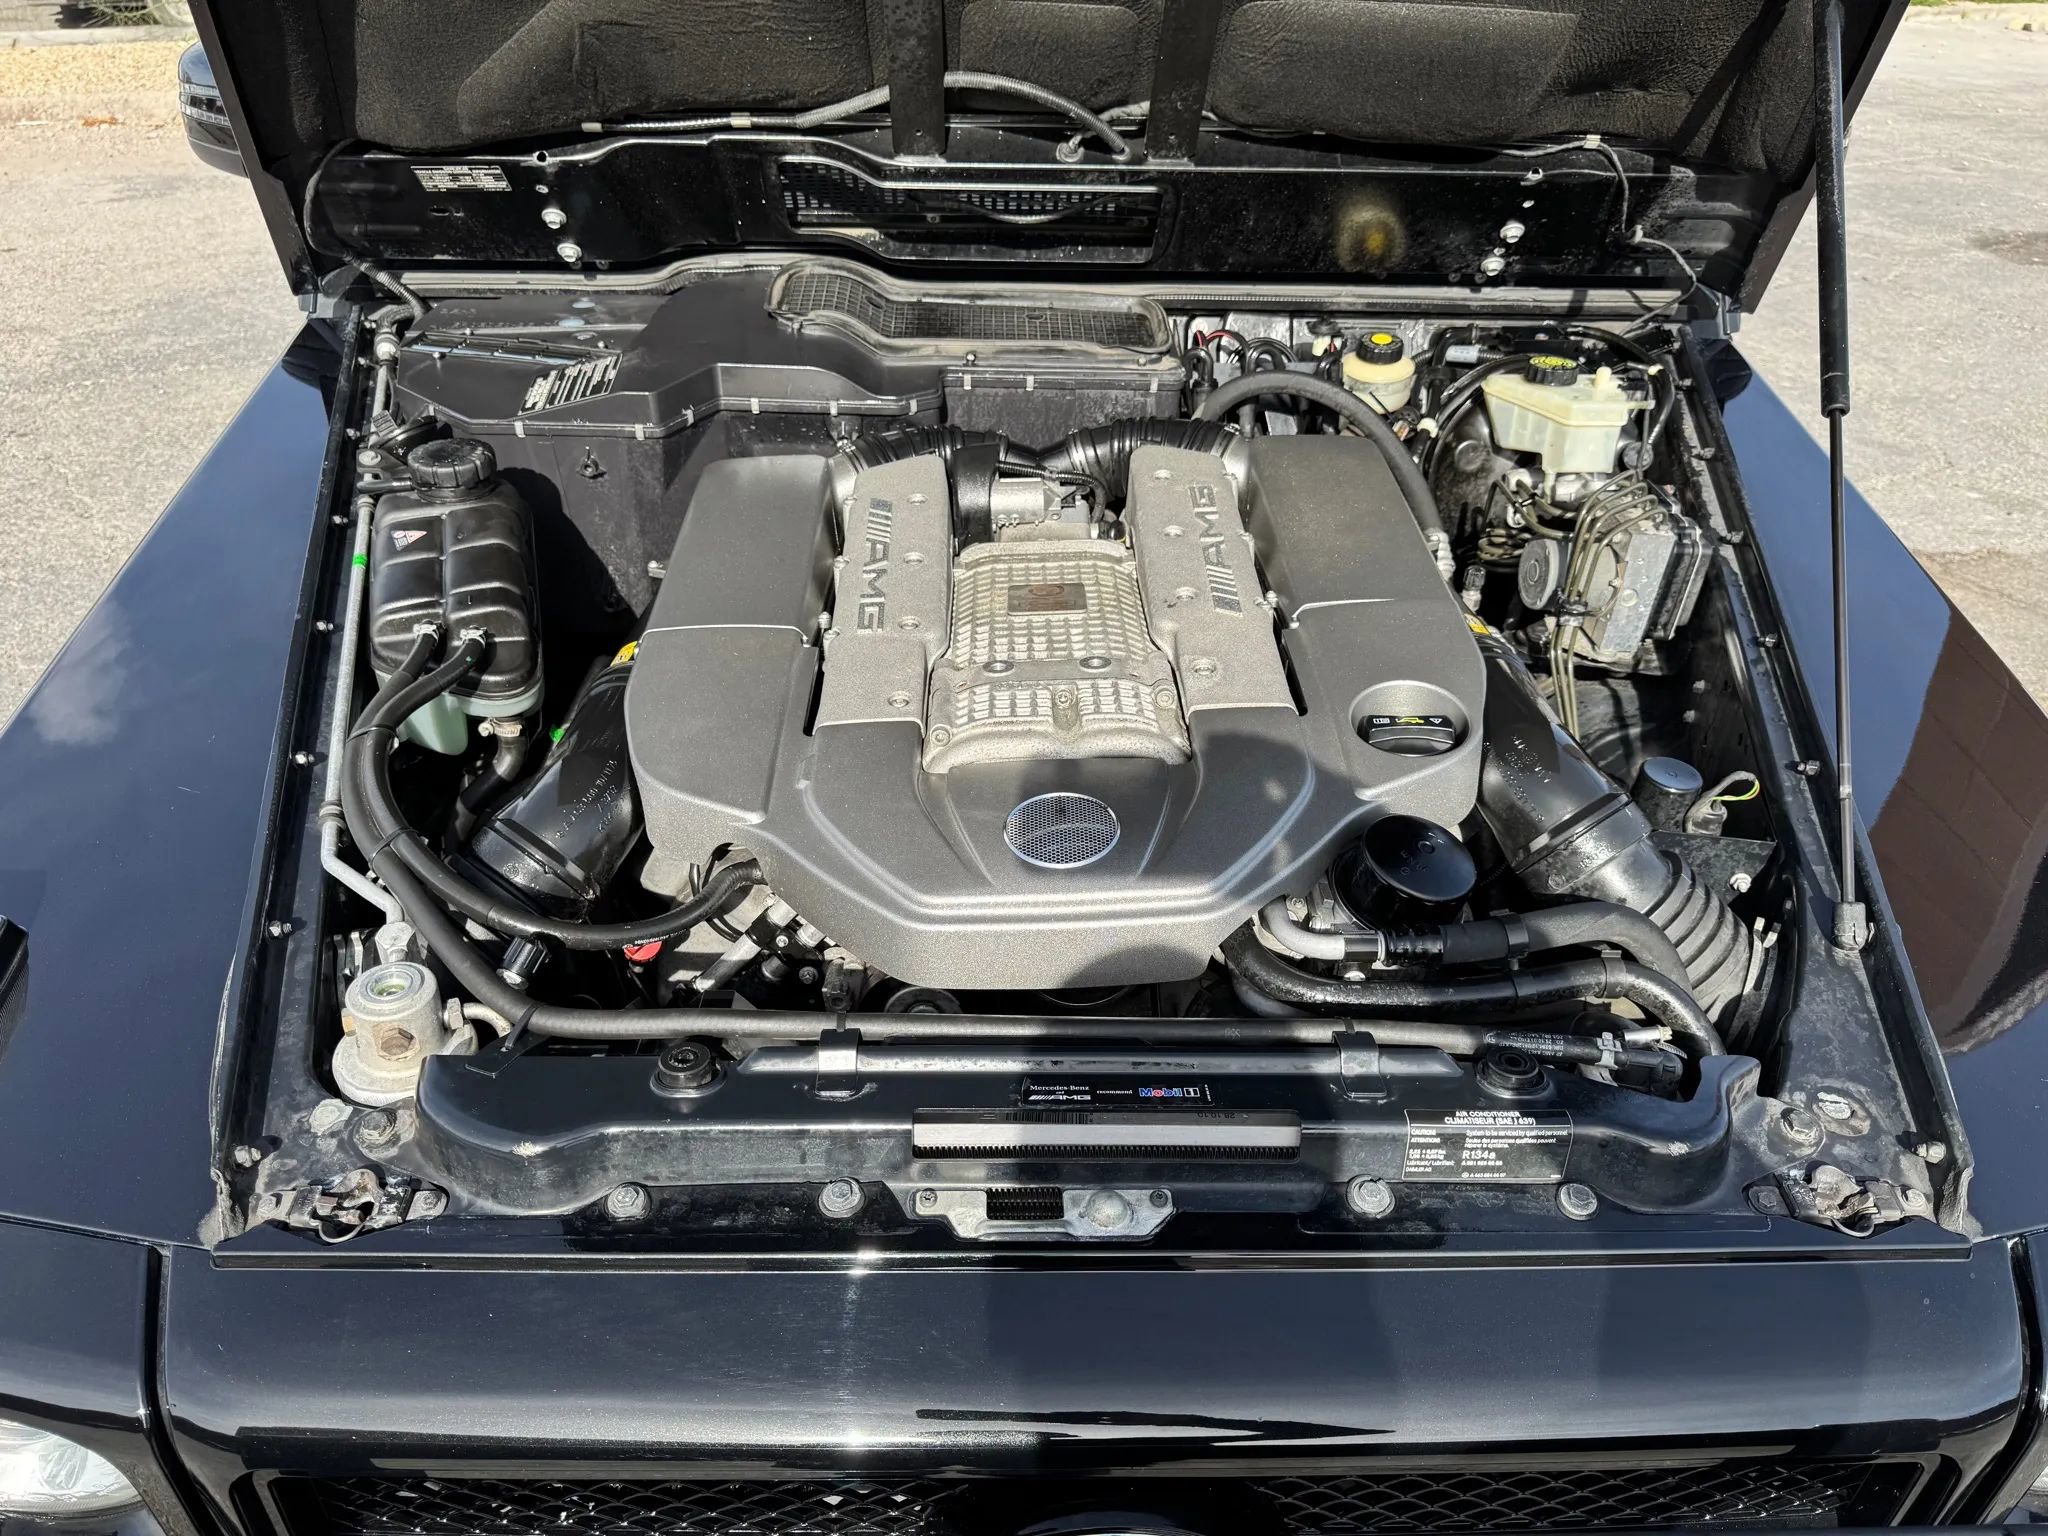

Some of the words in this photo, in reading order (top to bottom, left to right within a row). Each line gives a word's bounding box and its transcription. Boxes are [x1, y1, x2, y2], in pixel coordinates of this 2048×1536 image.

[1187, 485, 1226, 566] AMG
[857, 539, 890, 633] AMG
[1139, 1087, 1182, 1097] Mobil
[1444, 1117, 1495, 1125] CLIMATISEUR
[1496, 1117, 1513, 1126] (SAE
[1519, 1117, 1536, 1126] 639)
[1462, 1150, 1496, 1160] R134a
